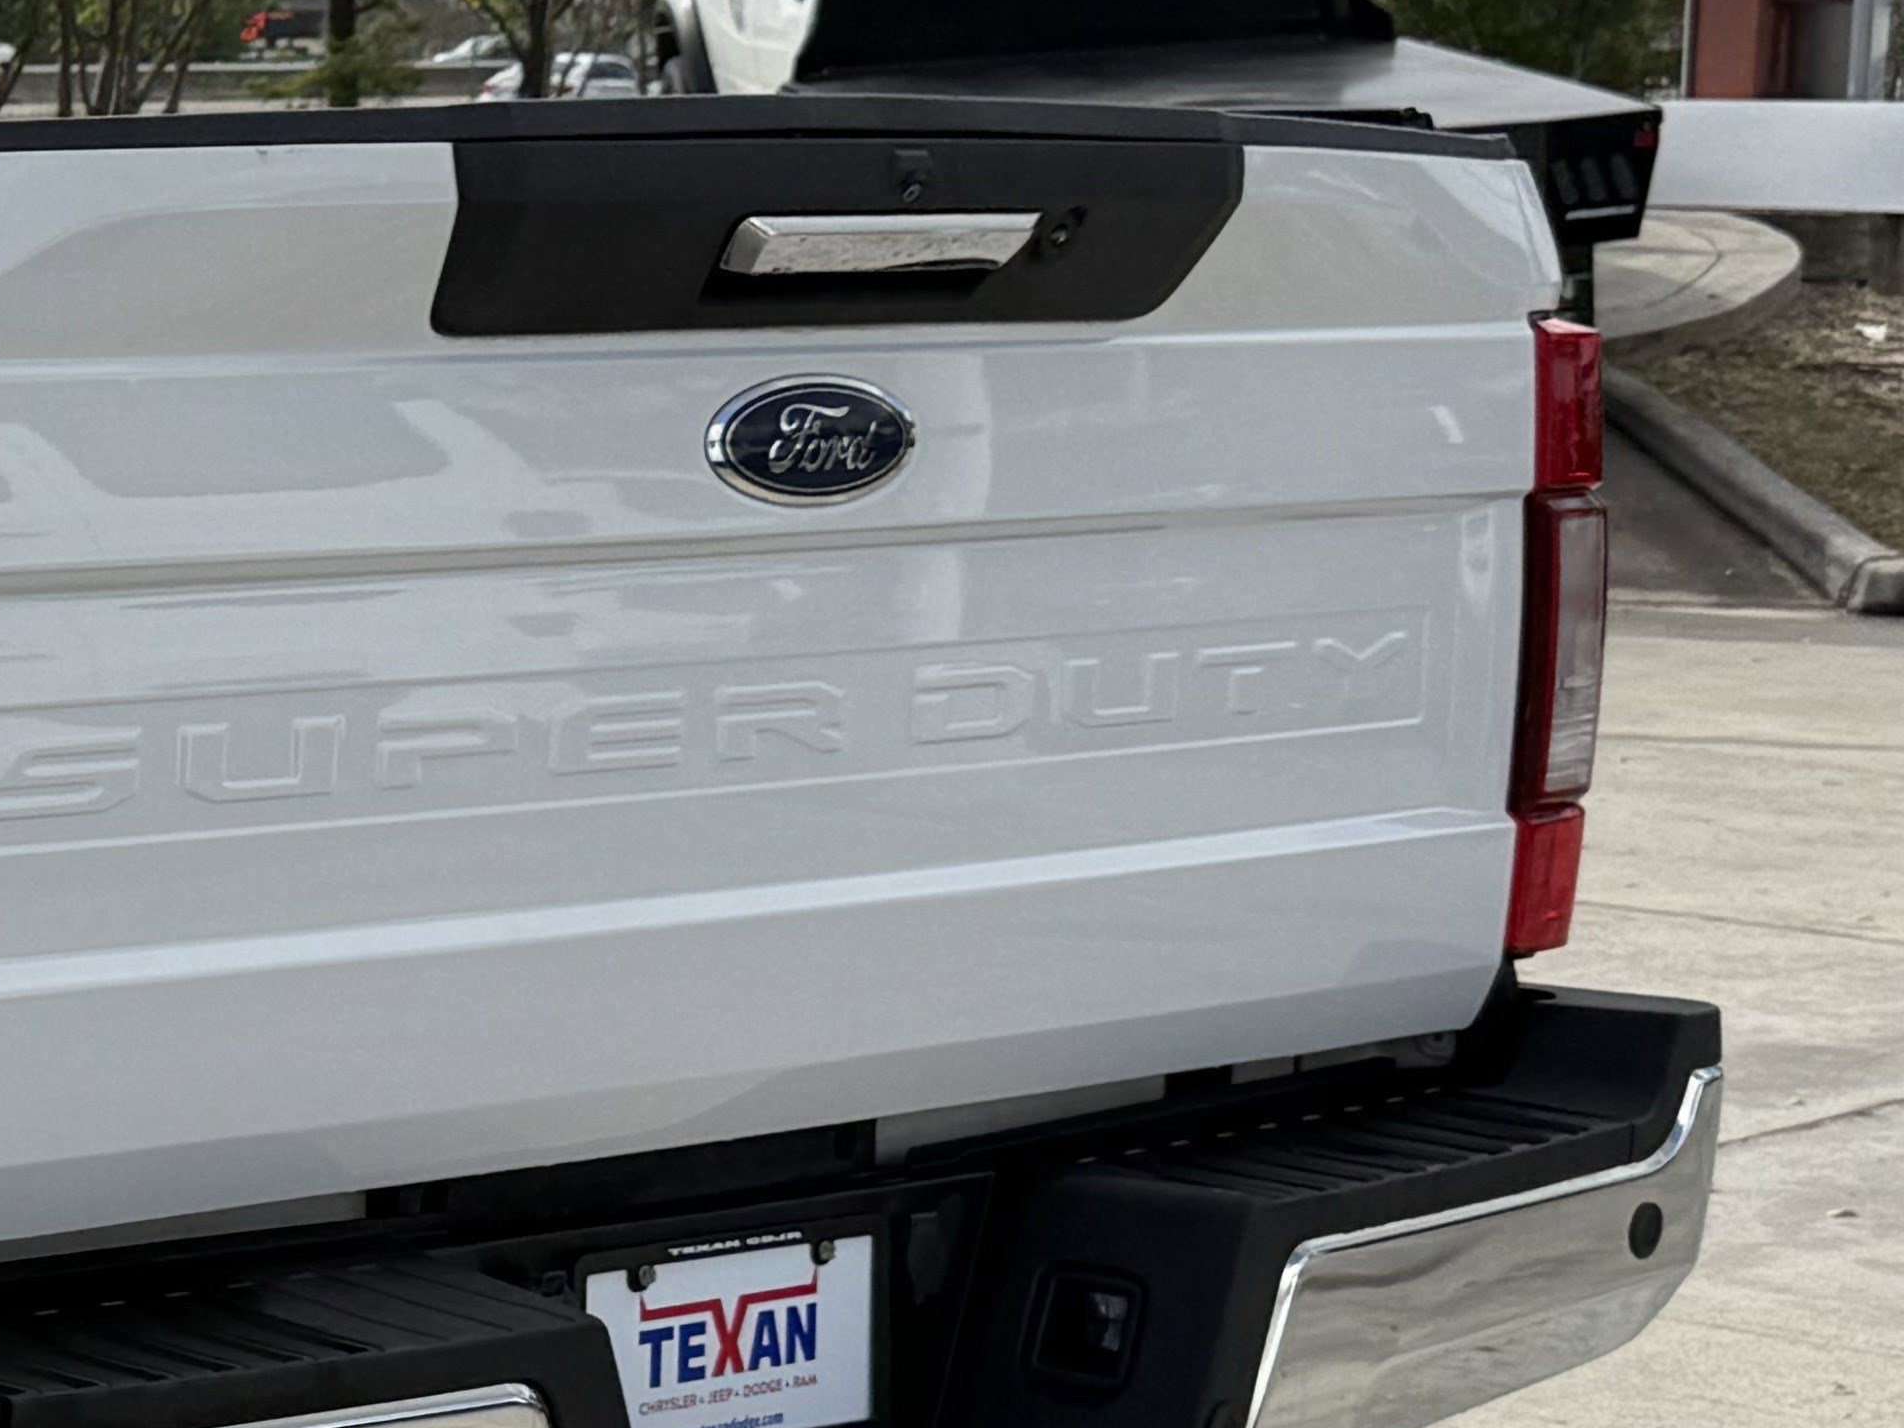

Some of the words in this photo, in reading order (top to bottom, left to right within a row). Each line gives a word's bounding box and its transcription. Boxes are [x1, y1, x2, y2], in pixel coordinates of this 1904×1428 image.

[768, 402, 878, 474] Ford
[909, 627, 1411, 746] DUTY
[668, 1239, 741, 1256] TEXAN
[638, 1298, 818, 1389] TEXAN
[639, 1395, 697, 1415] CHRYSLER
[707, 1387, 733, 1404] JEEP
[743, 1378, 784, 1399] DODGE
[791, 1374, 818, 1390] RAM
